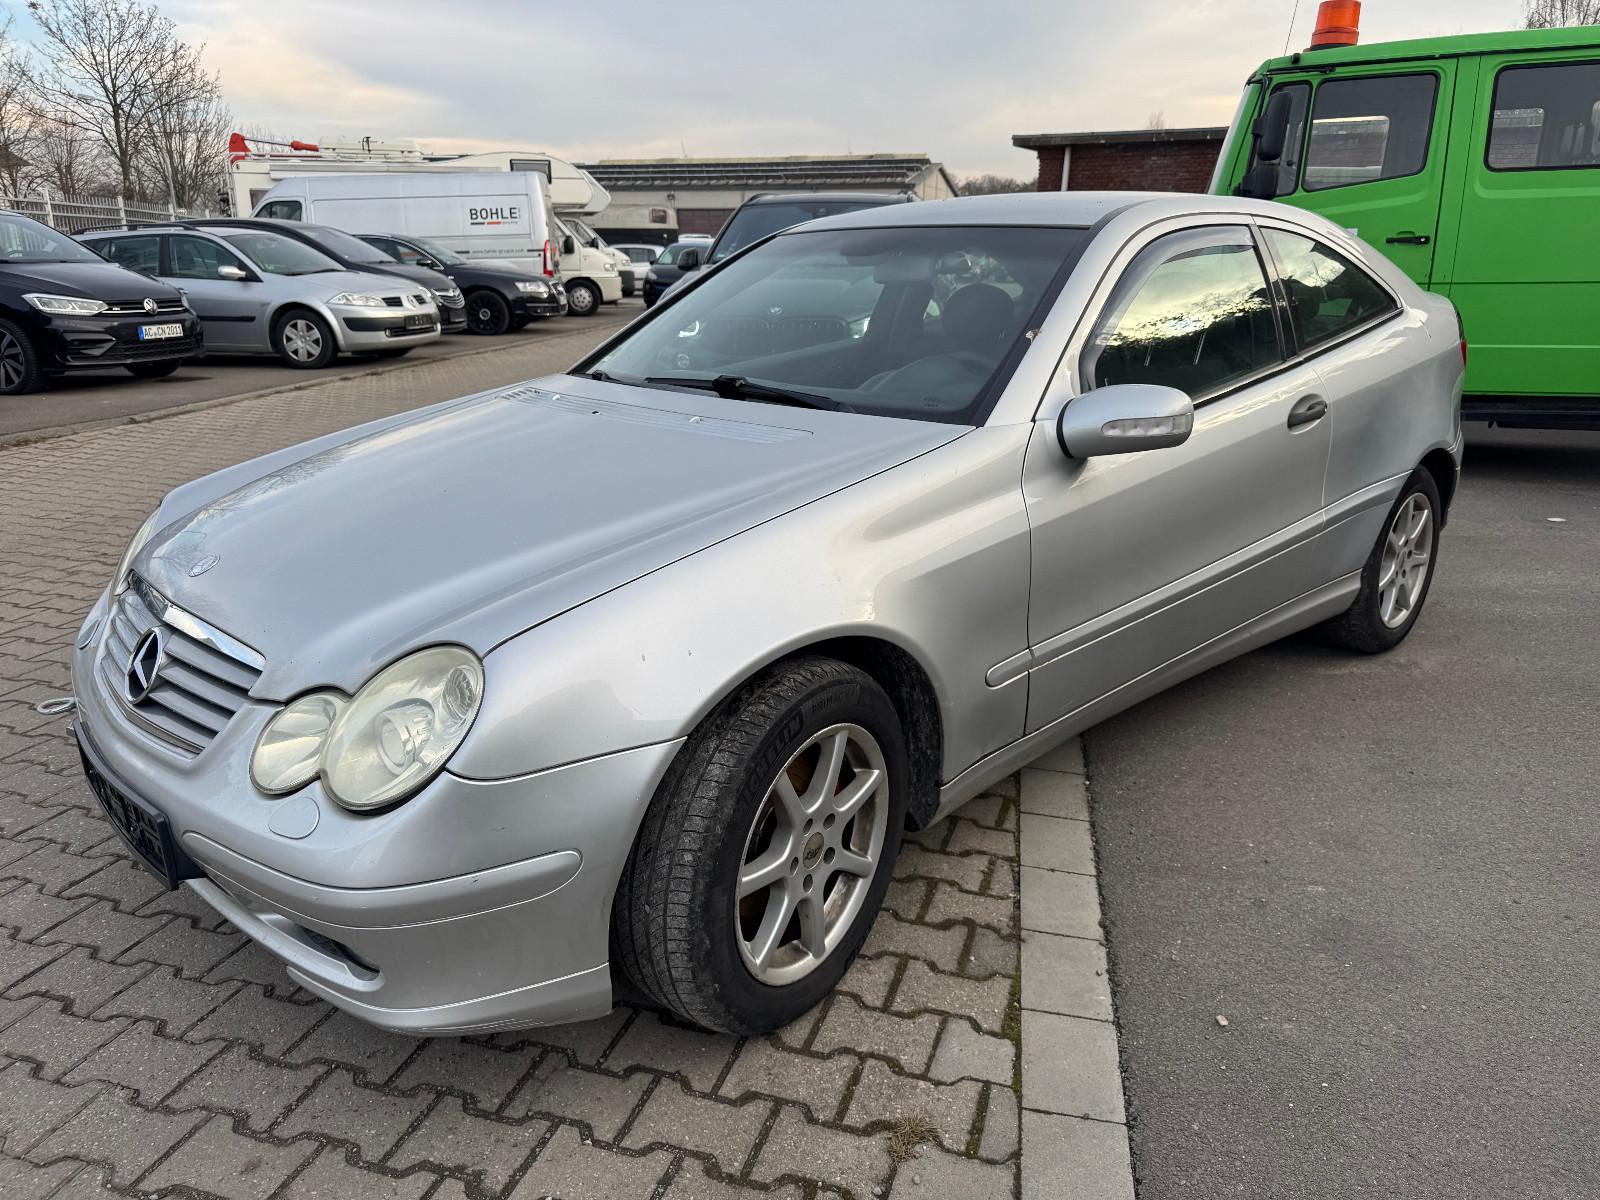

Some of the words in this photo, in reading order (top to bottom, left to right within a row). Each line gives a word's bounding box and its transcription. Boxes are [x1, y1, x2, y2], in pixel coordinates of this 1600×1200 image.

[470, 207, 517, 220] BOHLE
[144, 328, 154, 337] AC
[167, 325, 182, 335] 2011
